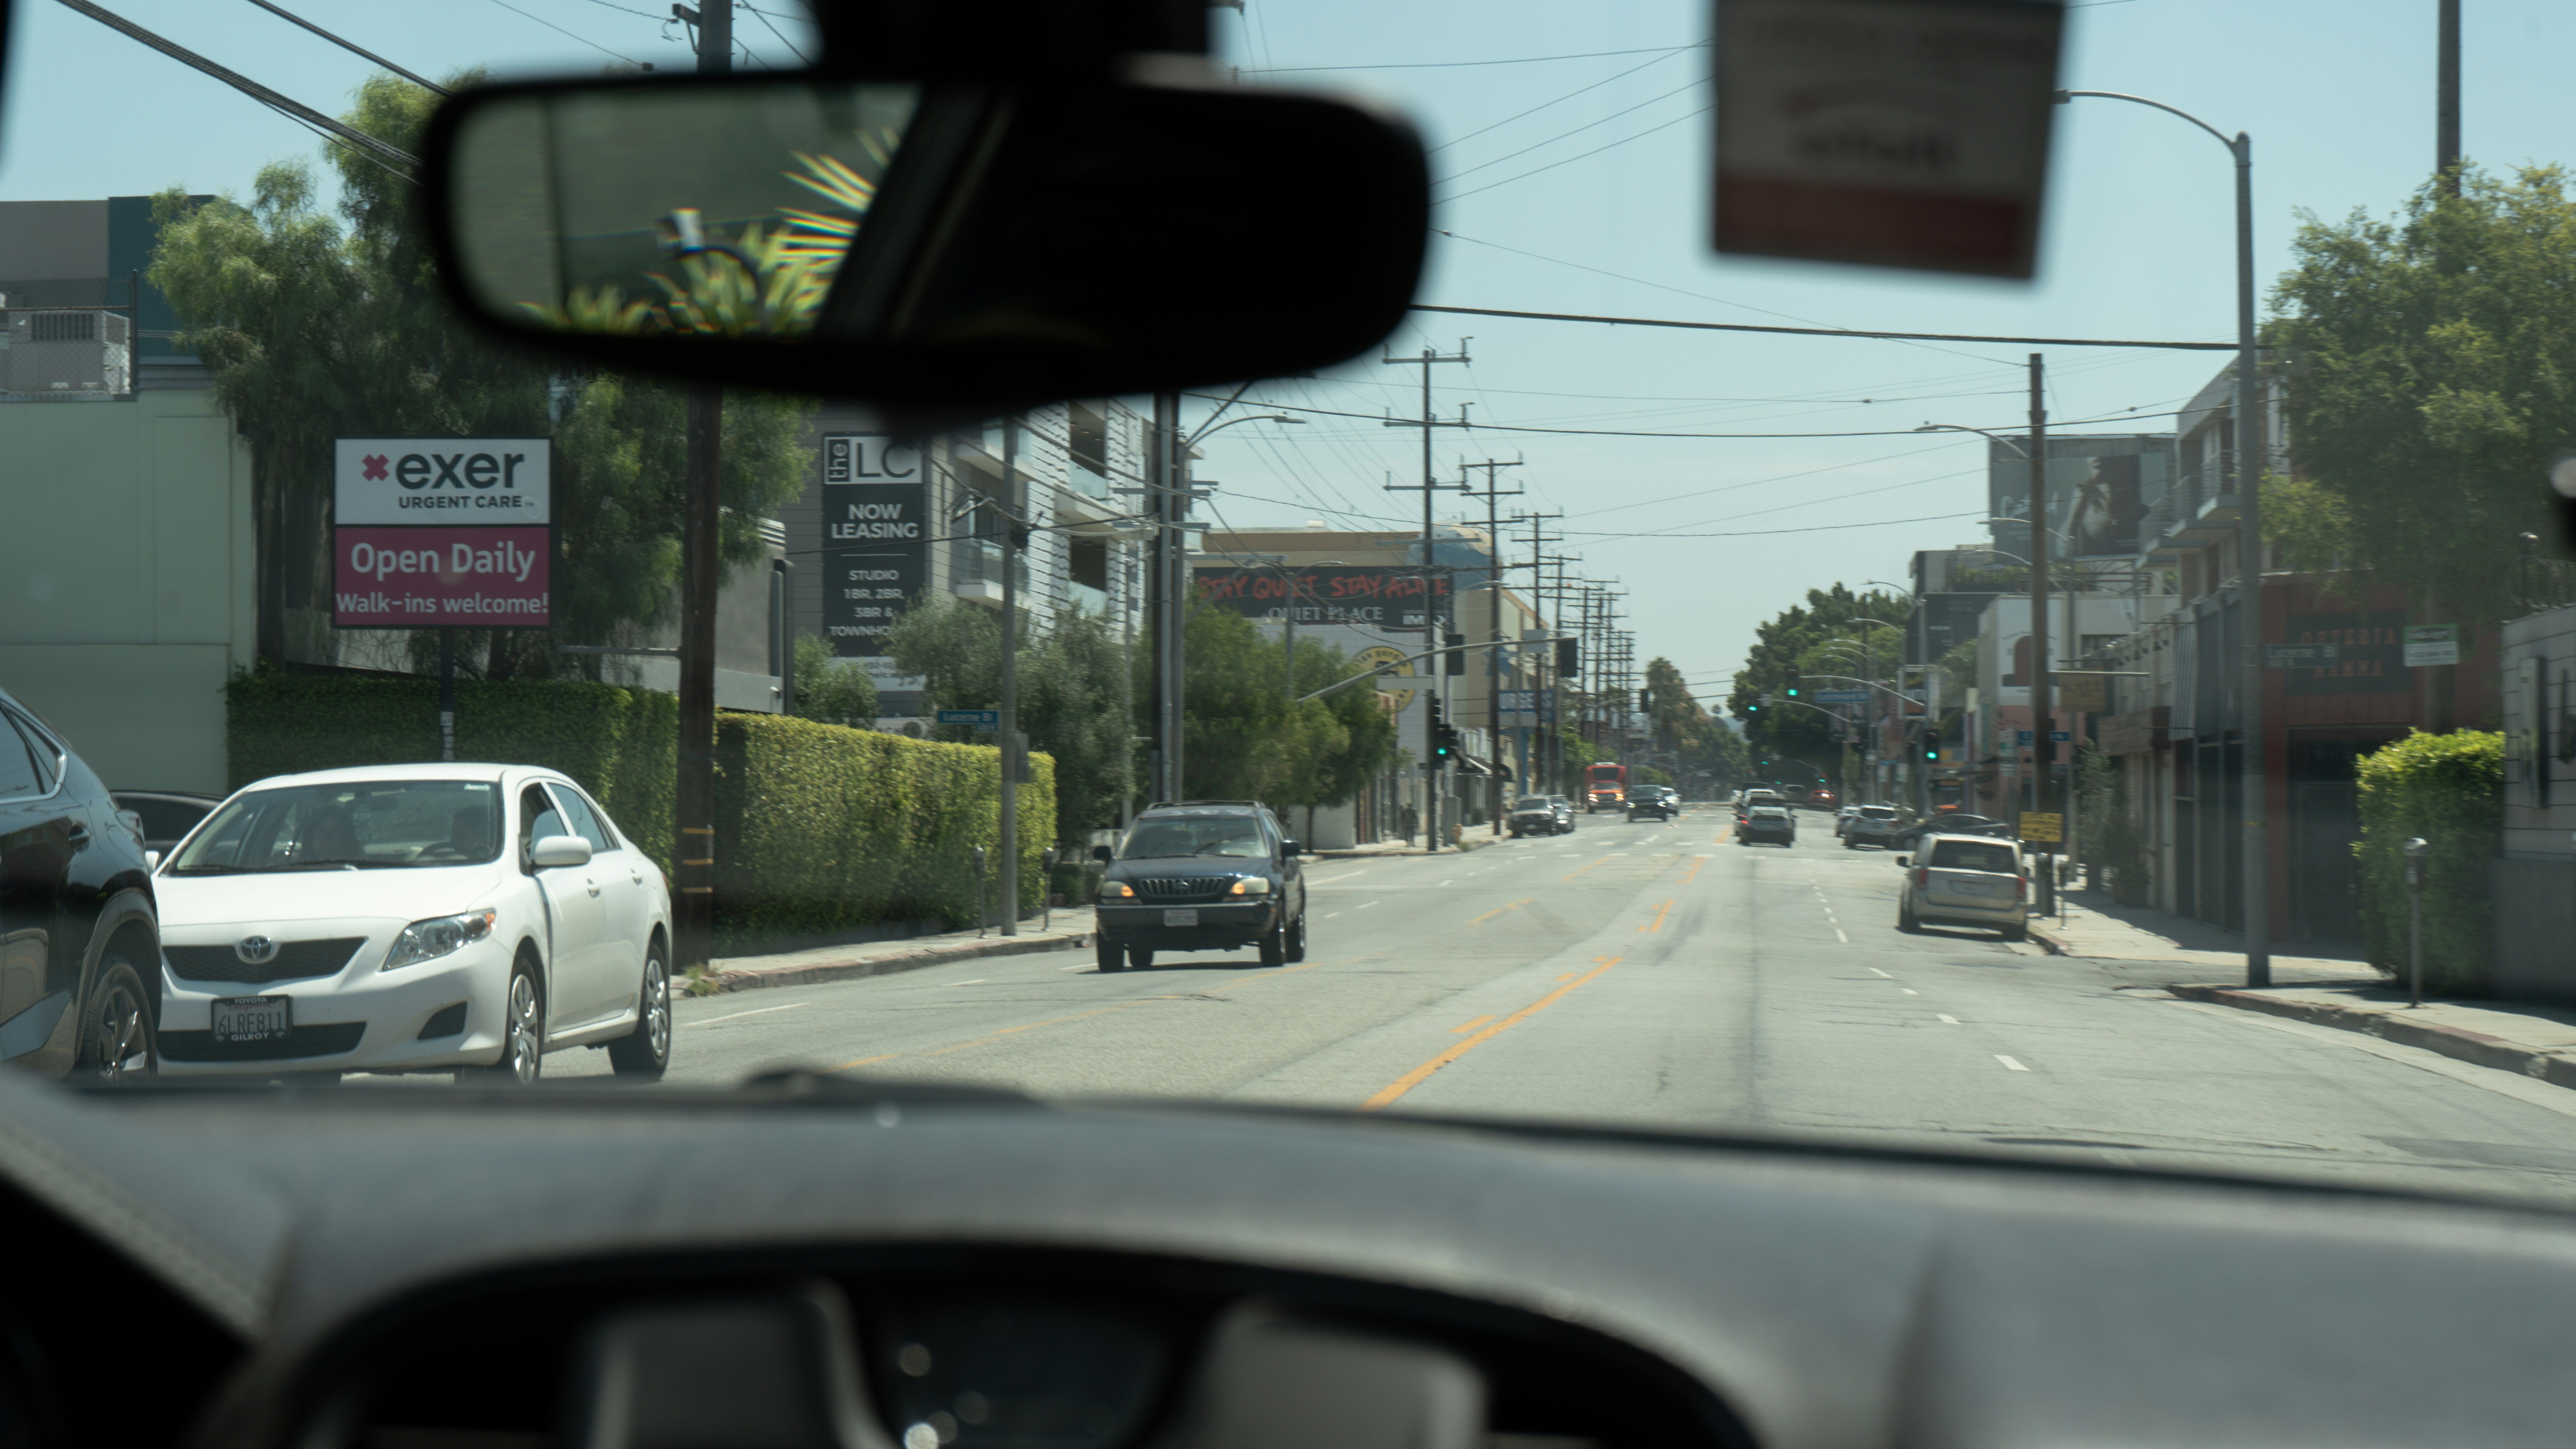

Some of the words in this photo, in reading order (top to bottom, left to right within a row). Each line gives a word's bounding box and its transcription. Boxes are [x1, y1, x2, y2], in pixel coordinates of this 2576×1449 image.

[829, 443, 848, 478] the
[856, 442, 917, 478] LC
[395, 453, 525, 490] exer
[398, 496, 471, 509] URGENT
[474, 495, 522, 508] CARE
[848, 504, 902, 520] NOW
[831, 522, 919, 539] LEASING
[351, 542, 440, 582] Open
[451, 540, 536, 582] Daily
[848, 570, 900, 581] STUDIO
[1197, 575, 1250, 600] STAY
[1252, 575, 1319, 600] QUET
[1329, 574, 1383, 598] STAY
[1385, 575, 1450, 599] ALIE
[336, 591, 437, 613] Walk-ins
[442, 592, 549, 613] welcome!
[1327, 606, 1384, 621] PLACE
[829, 625, 894, 636] TOWNHO
[2300, 627, 2398, 646] OSTERIA
[943, 712, 981, 722] Lucerne
[234, 996, 267, 1004] TOYOTA
[231, 1031, 269, 1042] GILROY
